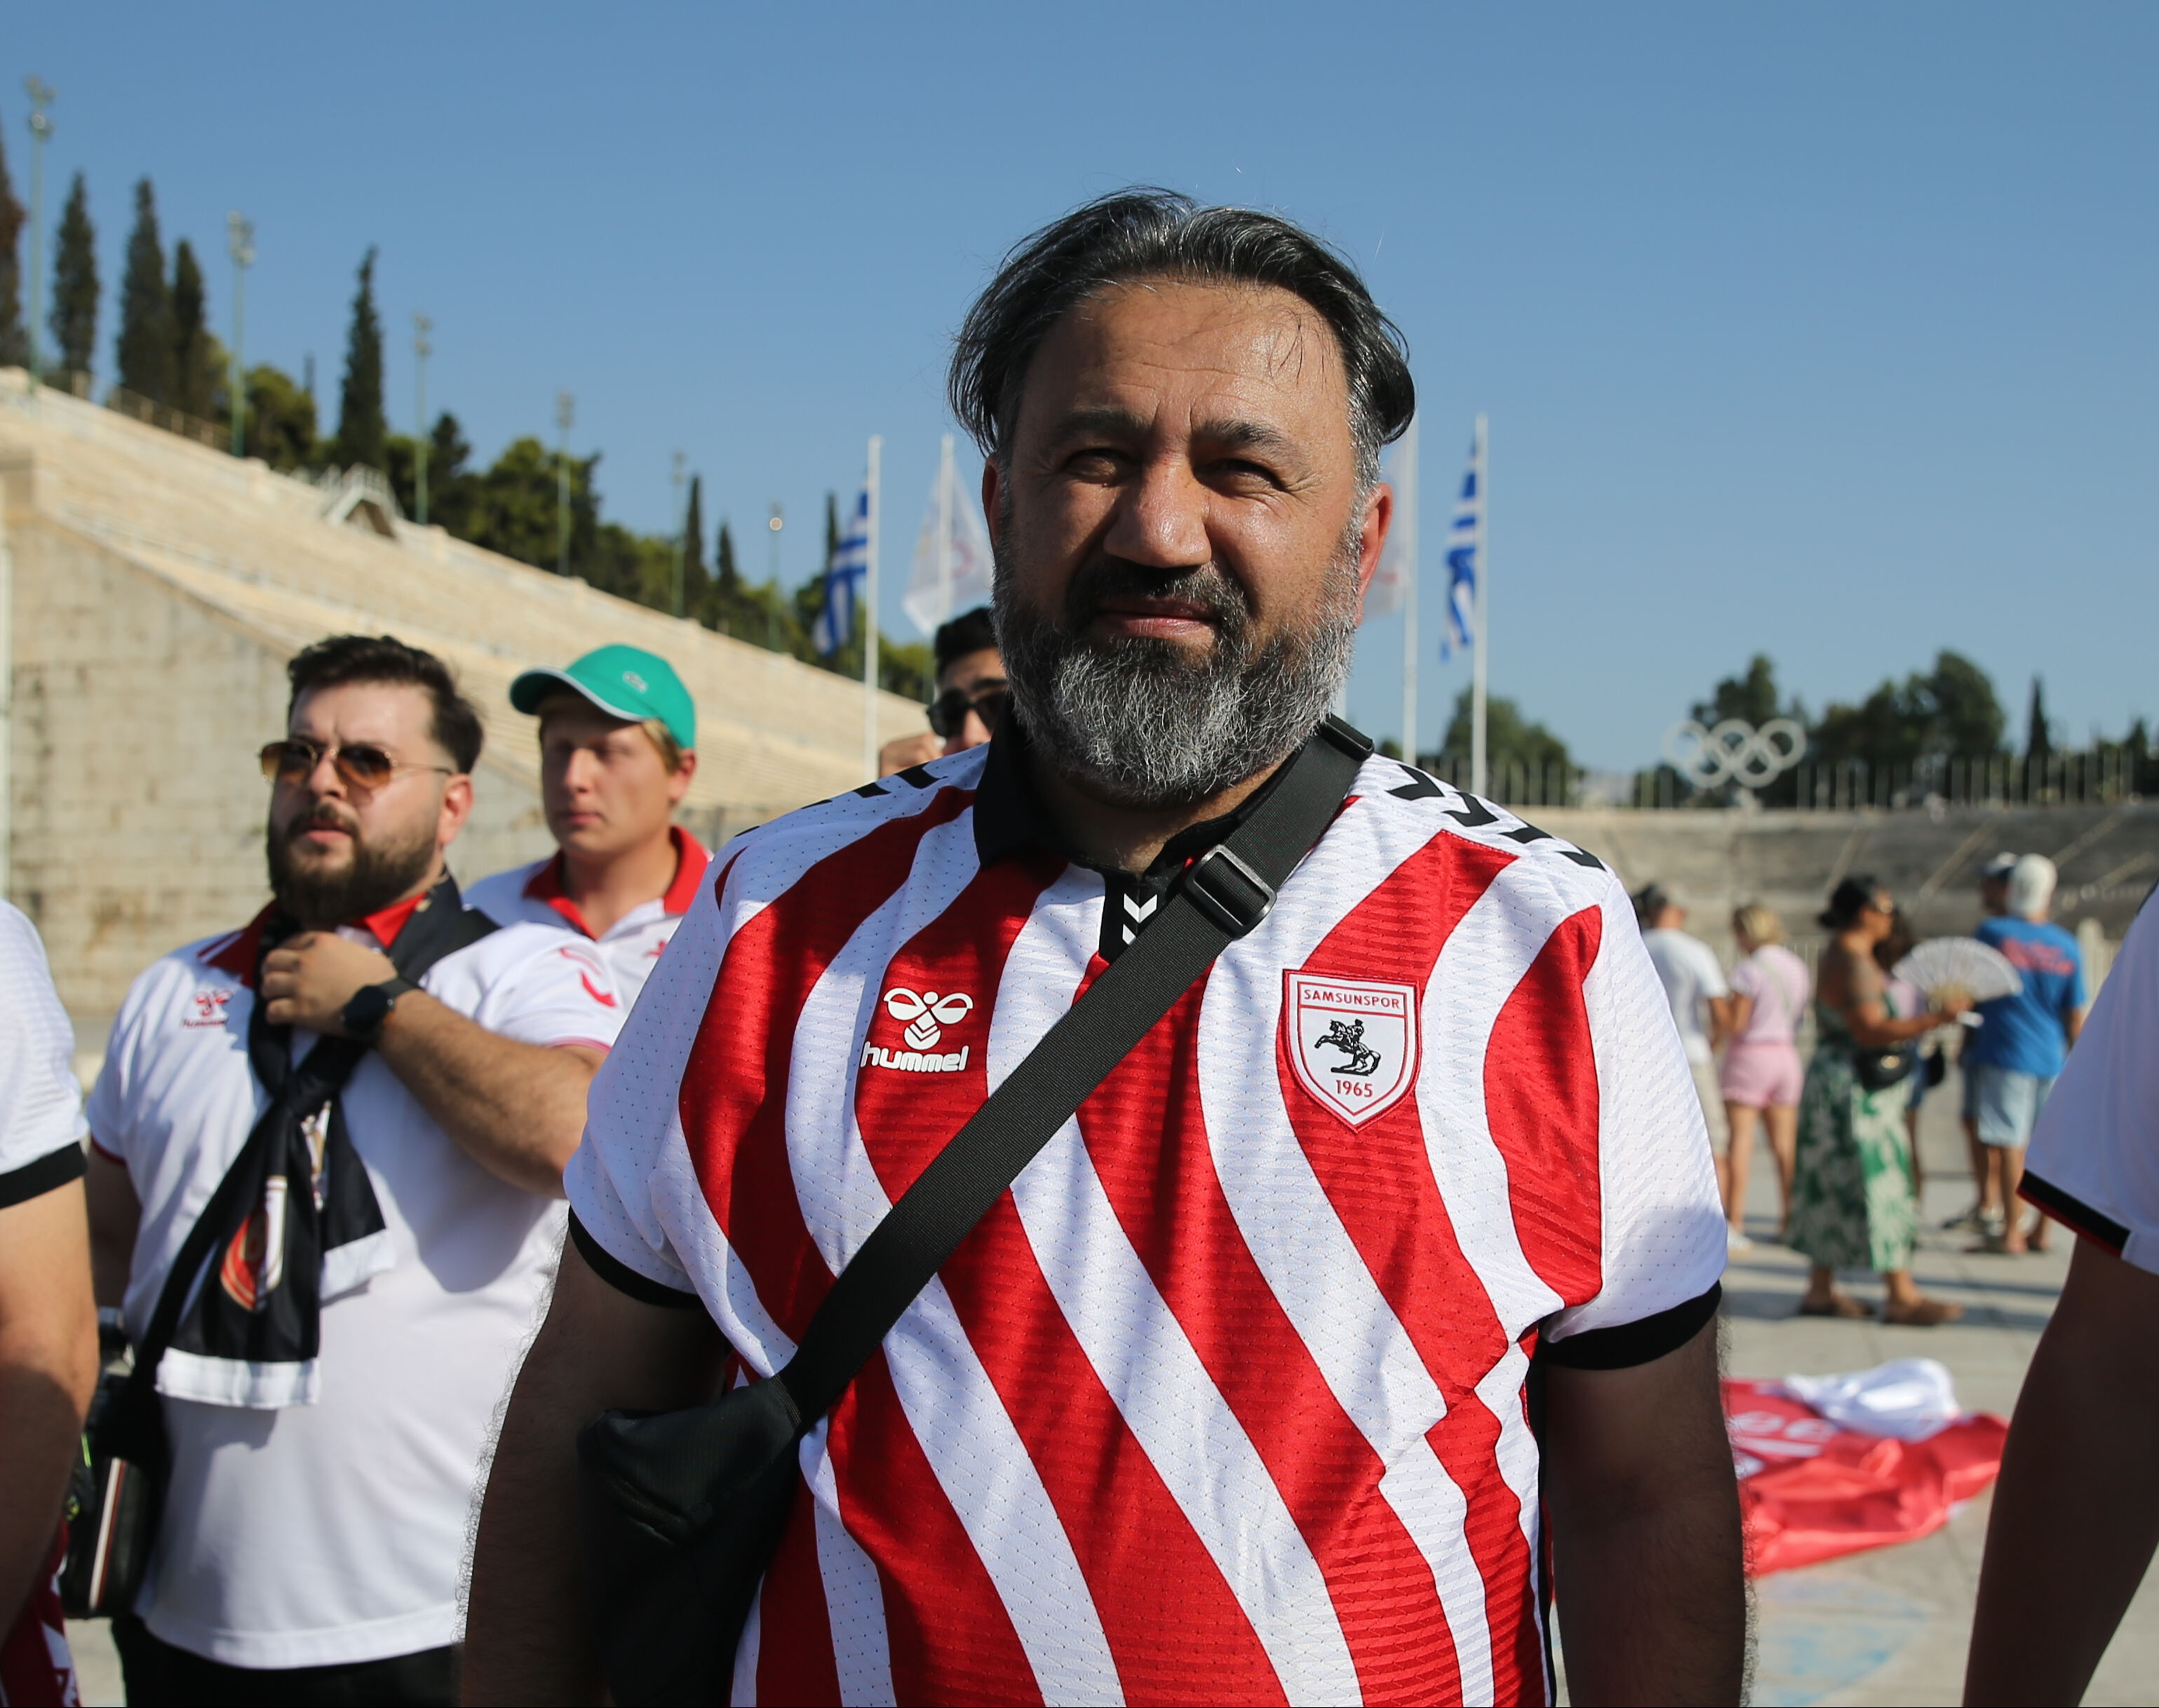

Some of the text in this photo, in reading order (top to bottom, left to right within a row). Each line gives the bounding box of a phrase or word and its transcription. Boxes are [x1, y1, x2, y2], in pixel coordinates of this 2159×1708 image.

[1304, 989, 1400, 1009] SAMSUNSPOR
[860, 1041, 969, 1072] hummel
[1336, 1080, 1373, 1098] 1965
